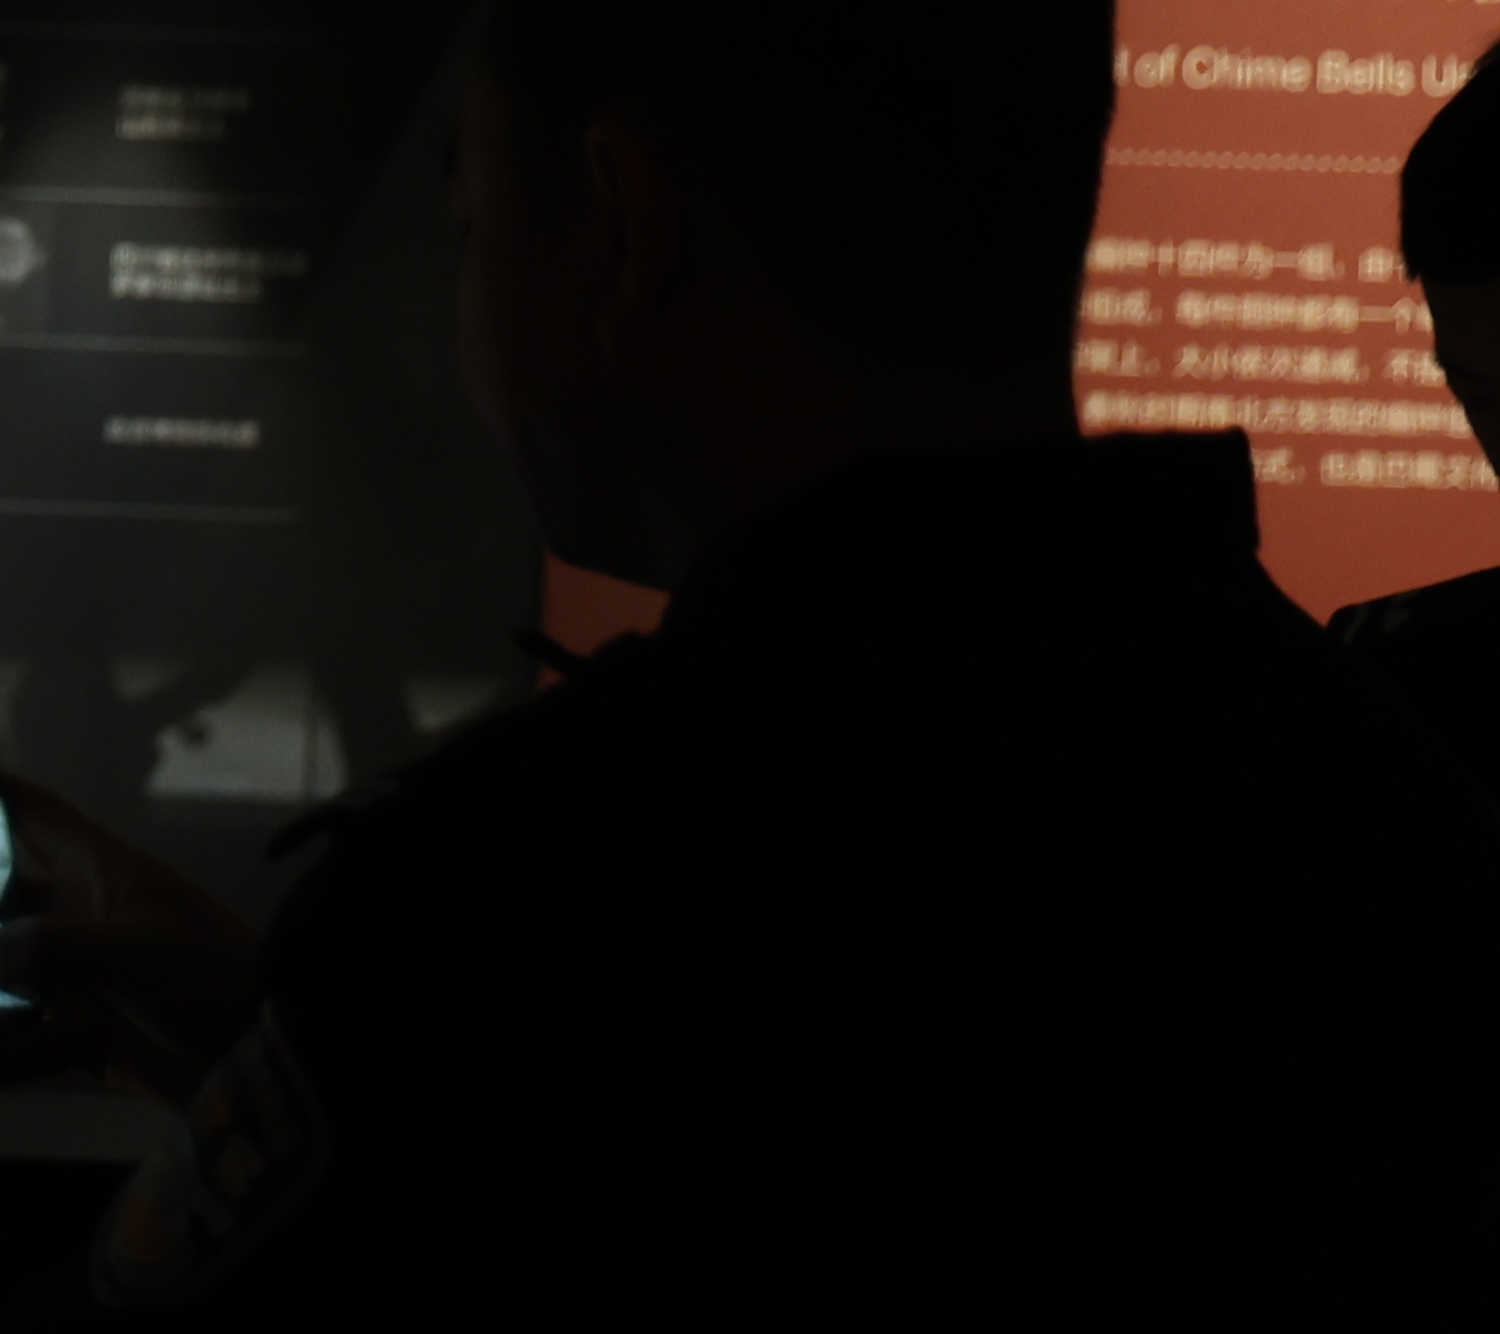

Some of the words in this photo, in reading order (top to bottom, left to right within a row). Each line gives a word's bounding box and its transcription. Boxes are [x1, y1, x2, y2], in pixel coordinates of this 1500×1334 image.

[1134, 43, 1181, 89] of
[1182, 44, 1311, 93] Chime
[1316, 49, 1415, 97] Bells
